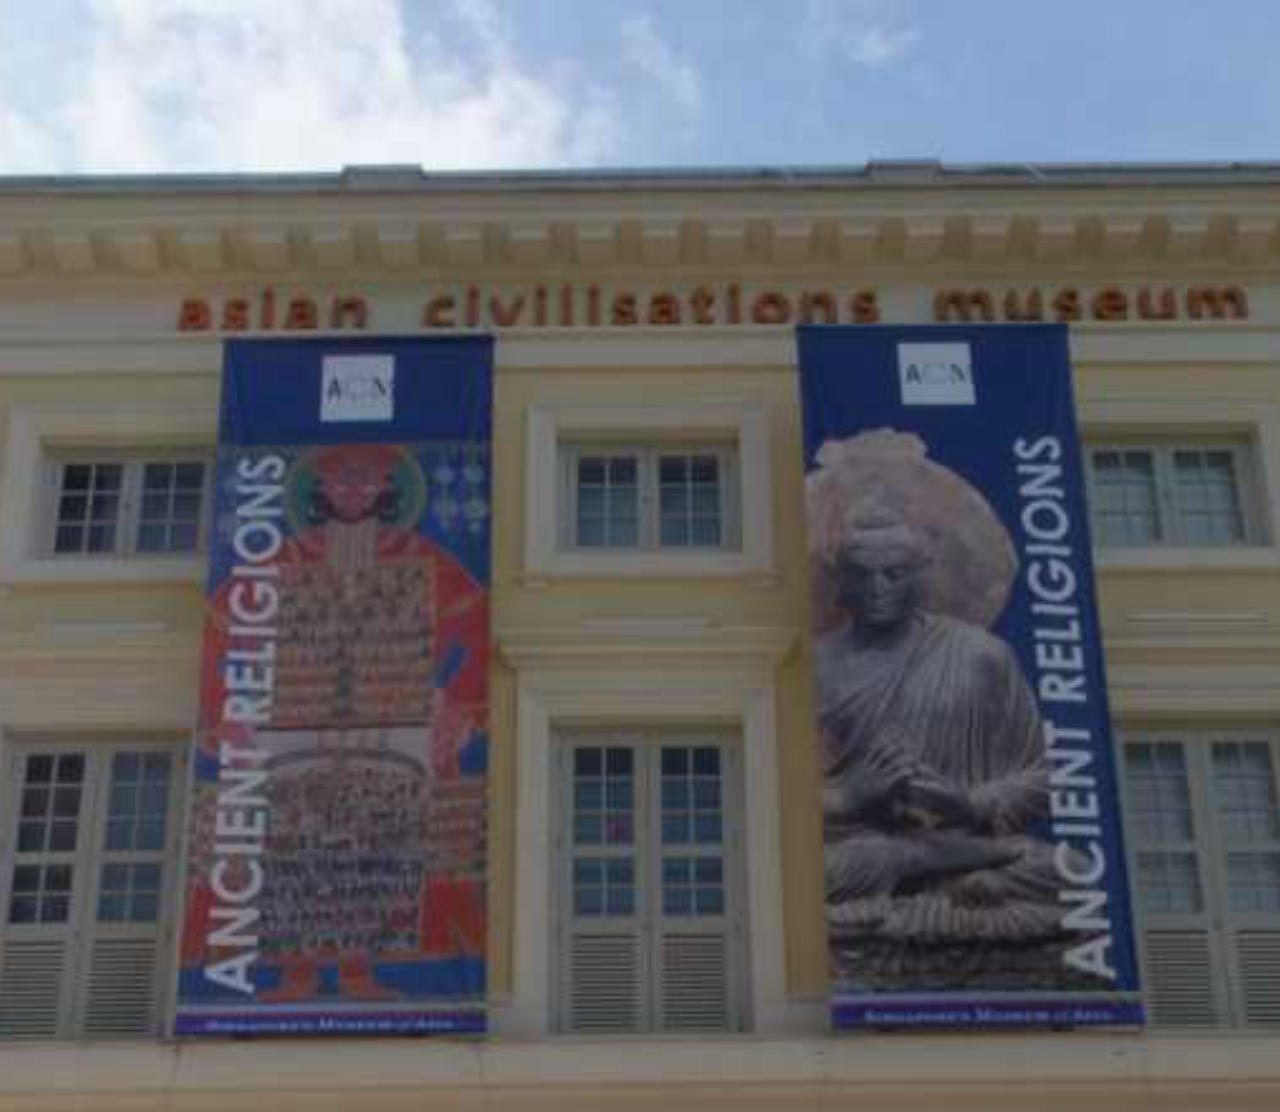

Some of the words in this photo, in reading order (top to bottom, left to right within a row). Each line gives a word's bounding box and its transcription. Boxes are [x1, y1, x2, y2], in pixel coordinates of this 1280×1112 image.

[177, 284, 368, 331] asian
[424, 283, 881, 327] civilisations
[933, 284, 1249, 322] museum
[223, 454, 287, 725] RELIGIONS
[1013, 434, 1087, 703] RELIGIONS
[204, 740, 271, 994] ANCIENT
[1044, 719, 1117, 980] ANCIENT
